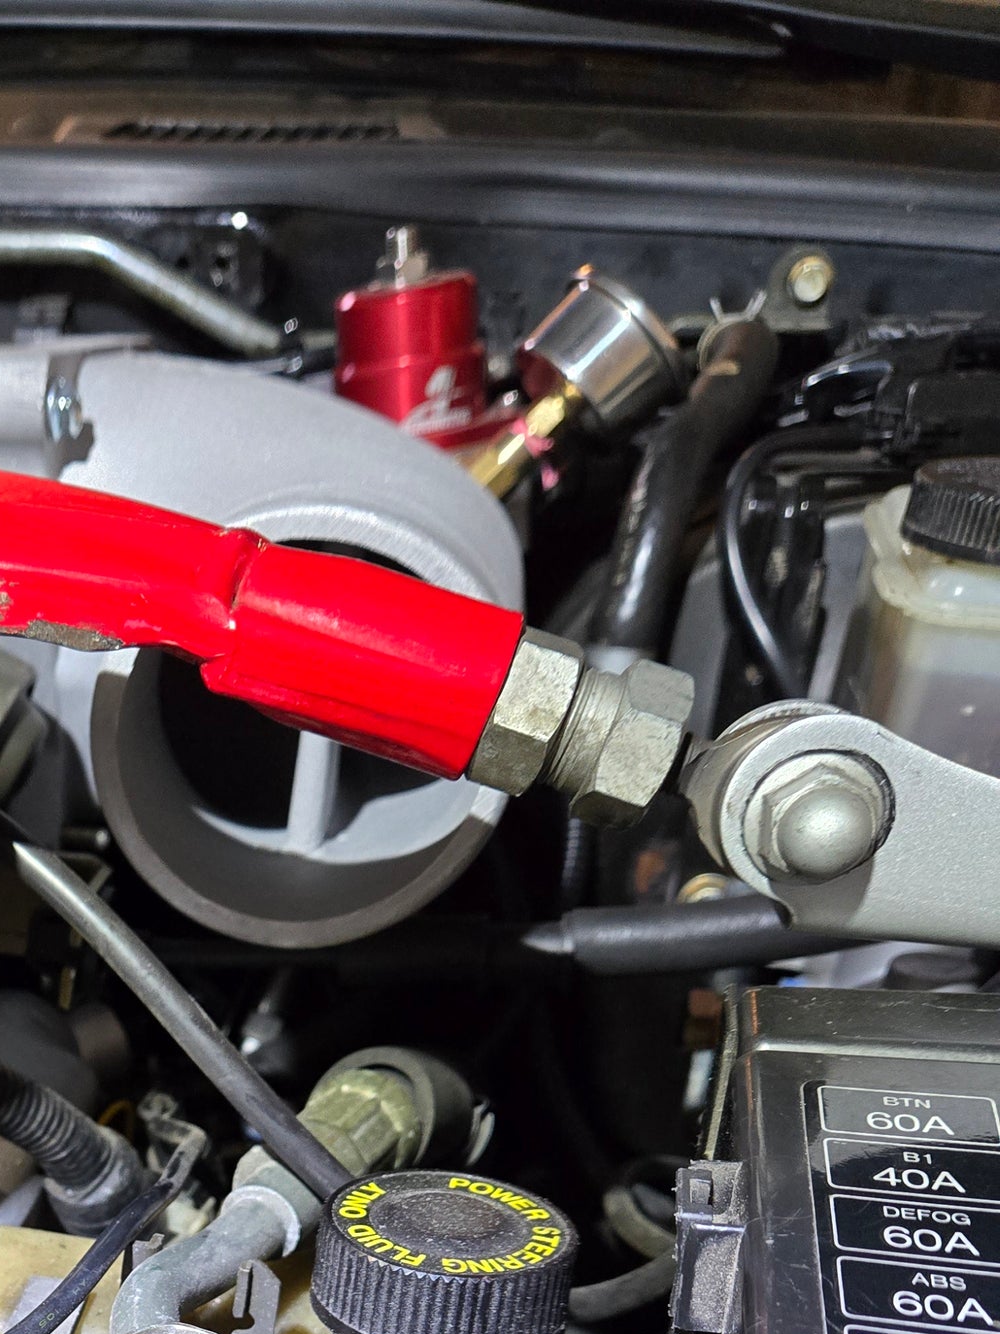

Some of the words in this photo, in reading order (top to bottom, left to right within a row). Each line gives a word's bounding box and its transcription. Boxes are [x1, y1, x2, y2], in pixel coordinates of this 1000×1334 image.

[883, 1096, 931, 1109] BTN
[866, 1111, 955, 1136] 60A
[902, 1151, 932, 1165] B1
[873, 1167, 966, 1193] 40A
[339, 1182, 387, 1219] ONLY
[448, 1177, 551, 1221] POWER
[883, 1205, 971, 1226] DEFOG
[347, 1224, 427, 1267] FLUID
[442, 1227, 561, 1274] STEERING
[883, 1225, 980, 1257] 60A
[911, 1272, 967, 1292] ABS
[892, 1290, 994, 1326] 60A
